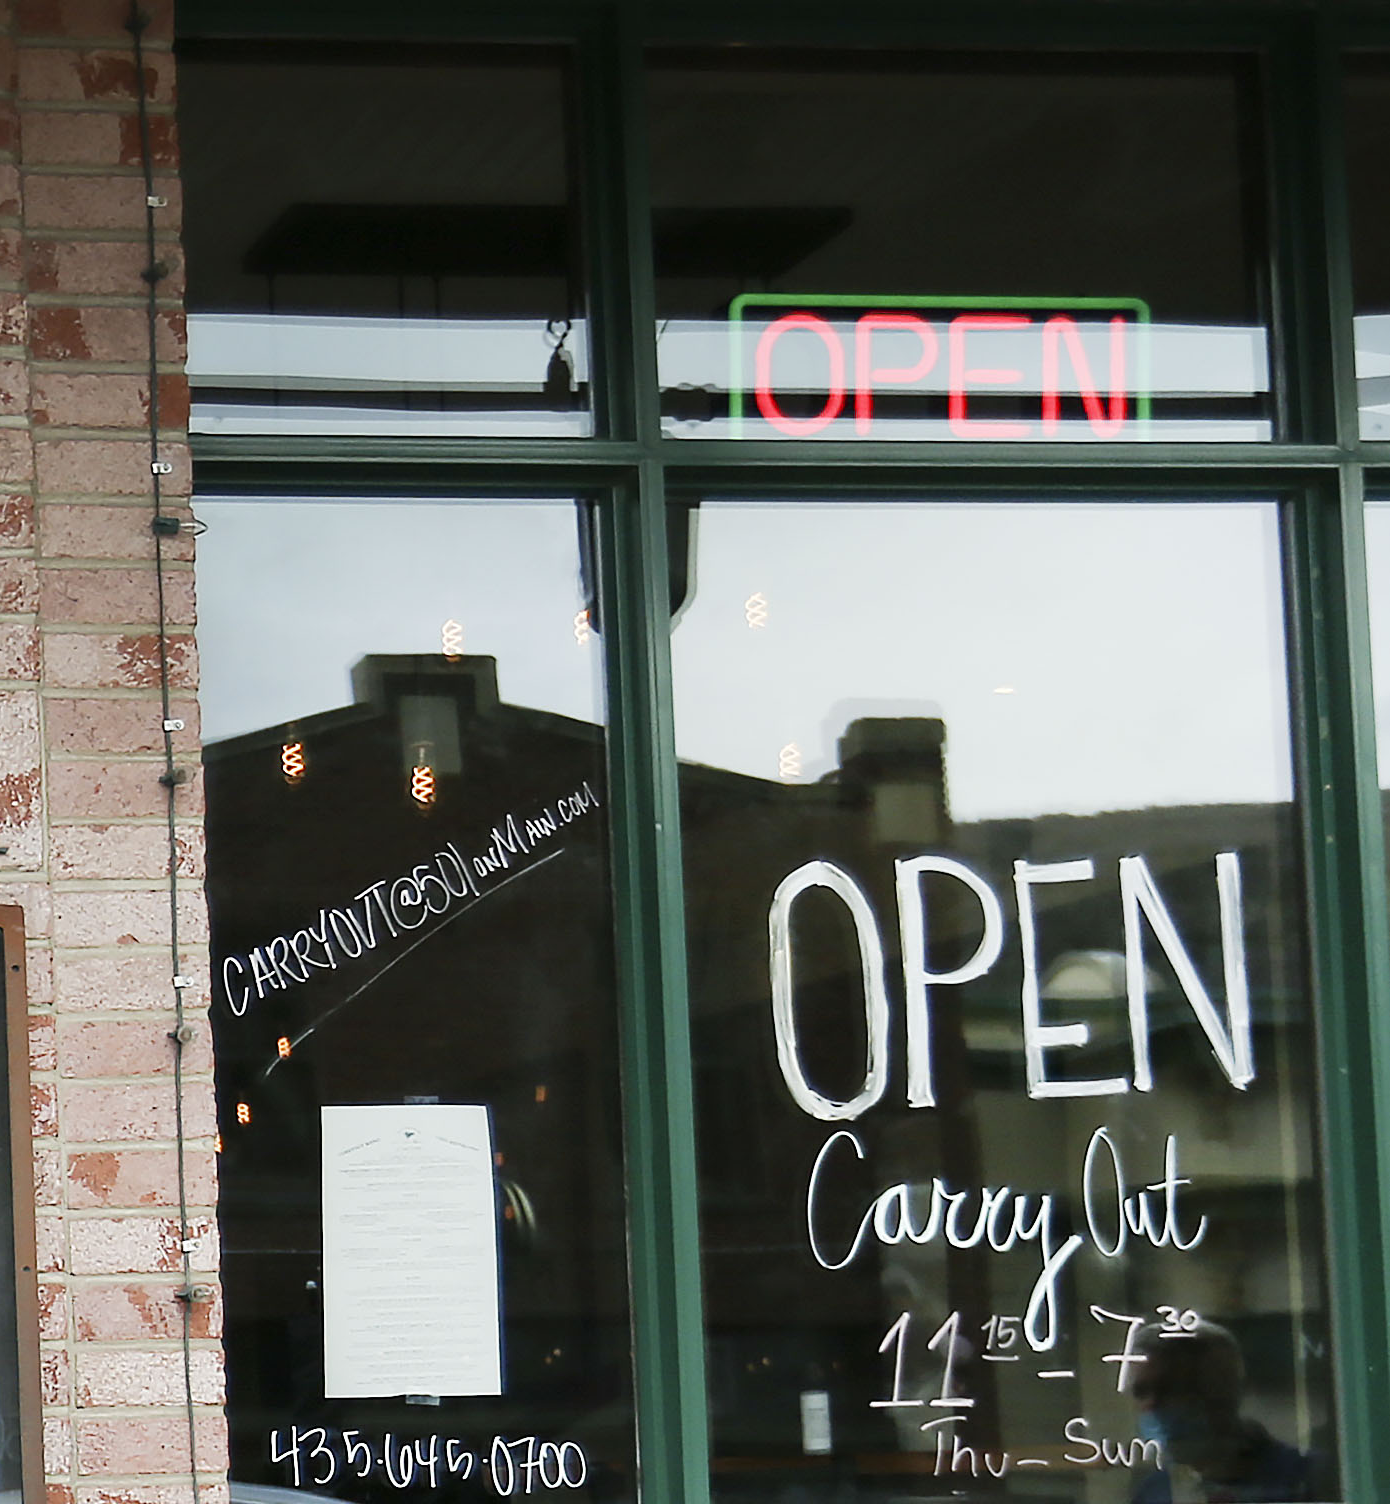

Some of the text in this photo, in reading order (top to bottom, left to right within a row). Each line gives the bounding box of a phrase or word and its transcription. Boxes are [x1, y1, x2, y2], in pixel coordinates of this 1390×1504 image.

[755, 312, 1127, 437] OPEN
[768, 852, 1256, 1121] OPEN
[807, 1127, 1206, 1353] Carry Out
